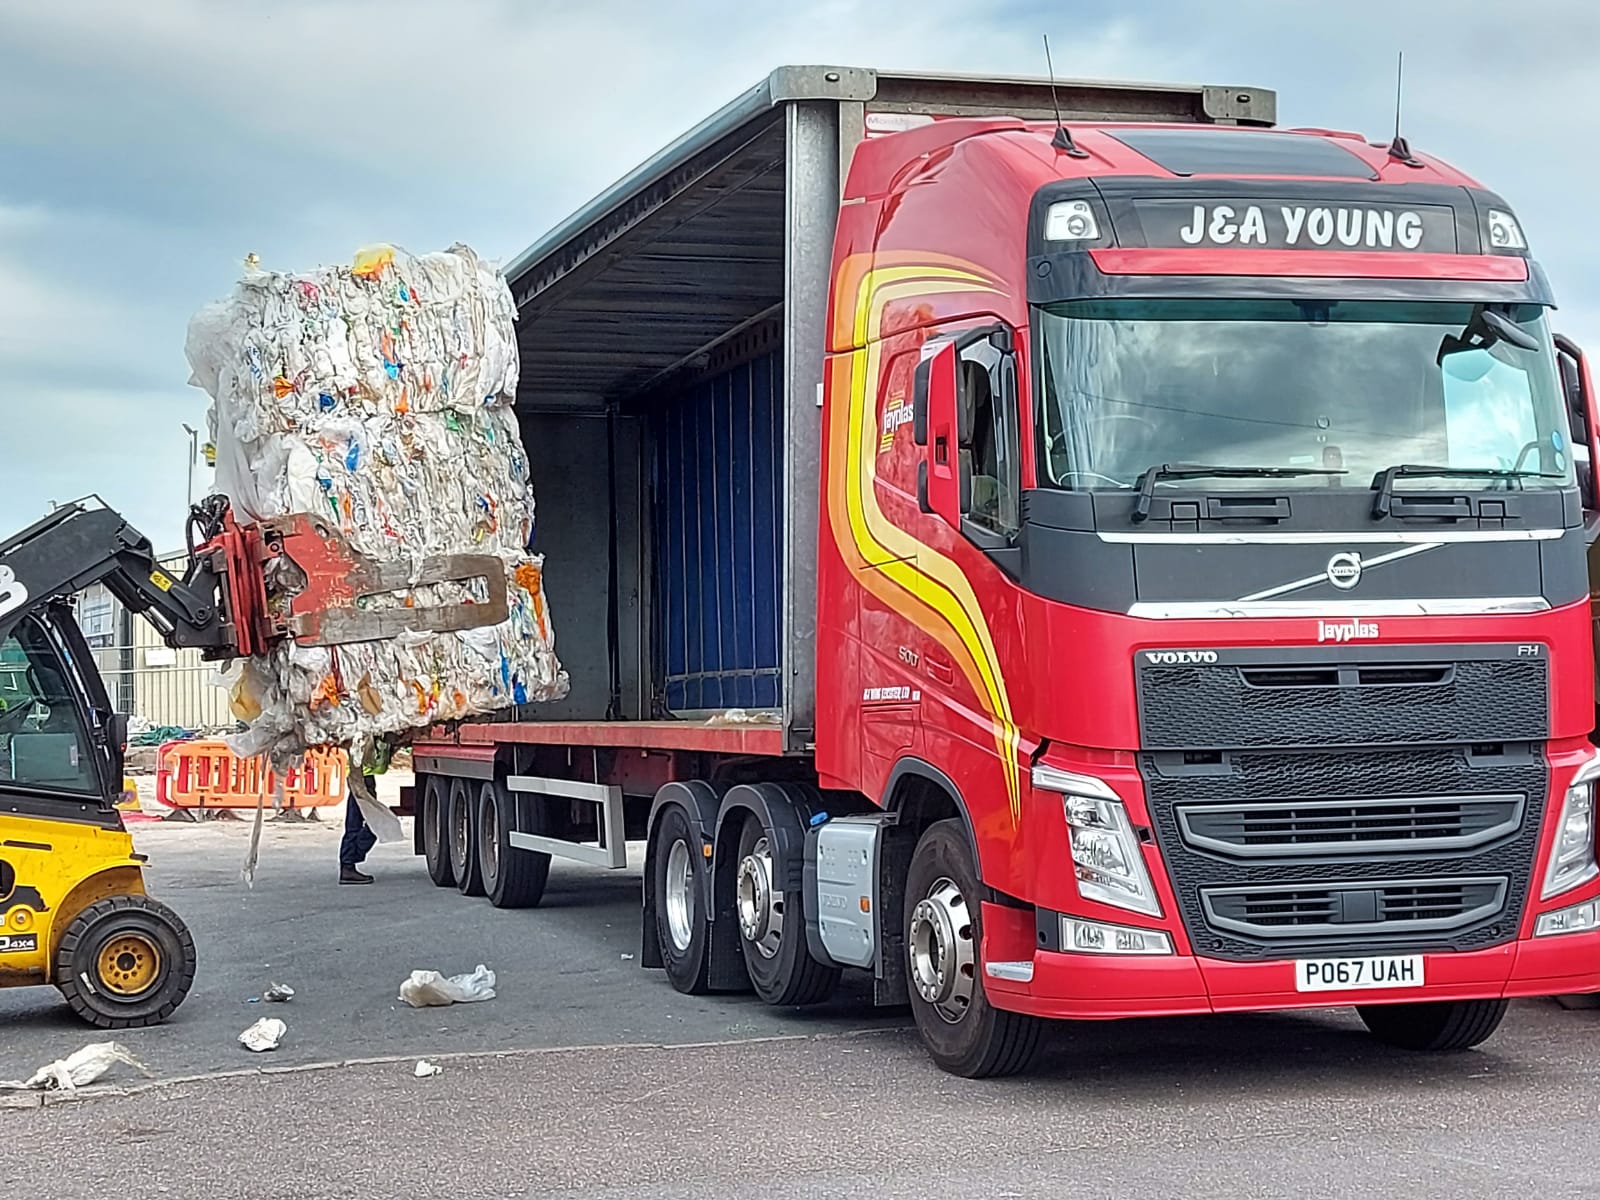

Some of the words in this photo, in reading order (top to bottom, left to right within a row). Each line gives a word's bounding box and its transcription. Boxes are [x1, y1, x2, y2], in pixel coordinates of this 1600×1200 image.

[1180, 206, 1268, 244] J&A
[1281, 207, 1423, 249] YOUNG
[1145, 651, 1218, 664] VOLVO
[1517, 645, 1539, 656] FH
[1306, 961, 1364, 985] PO67
[1371, 959, 1414, 981] UAH
